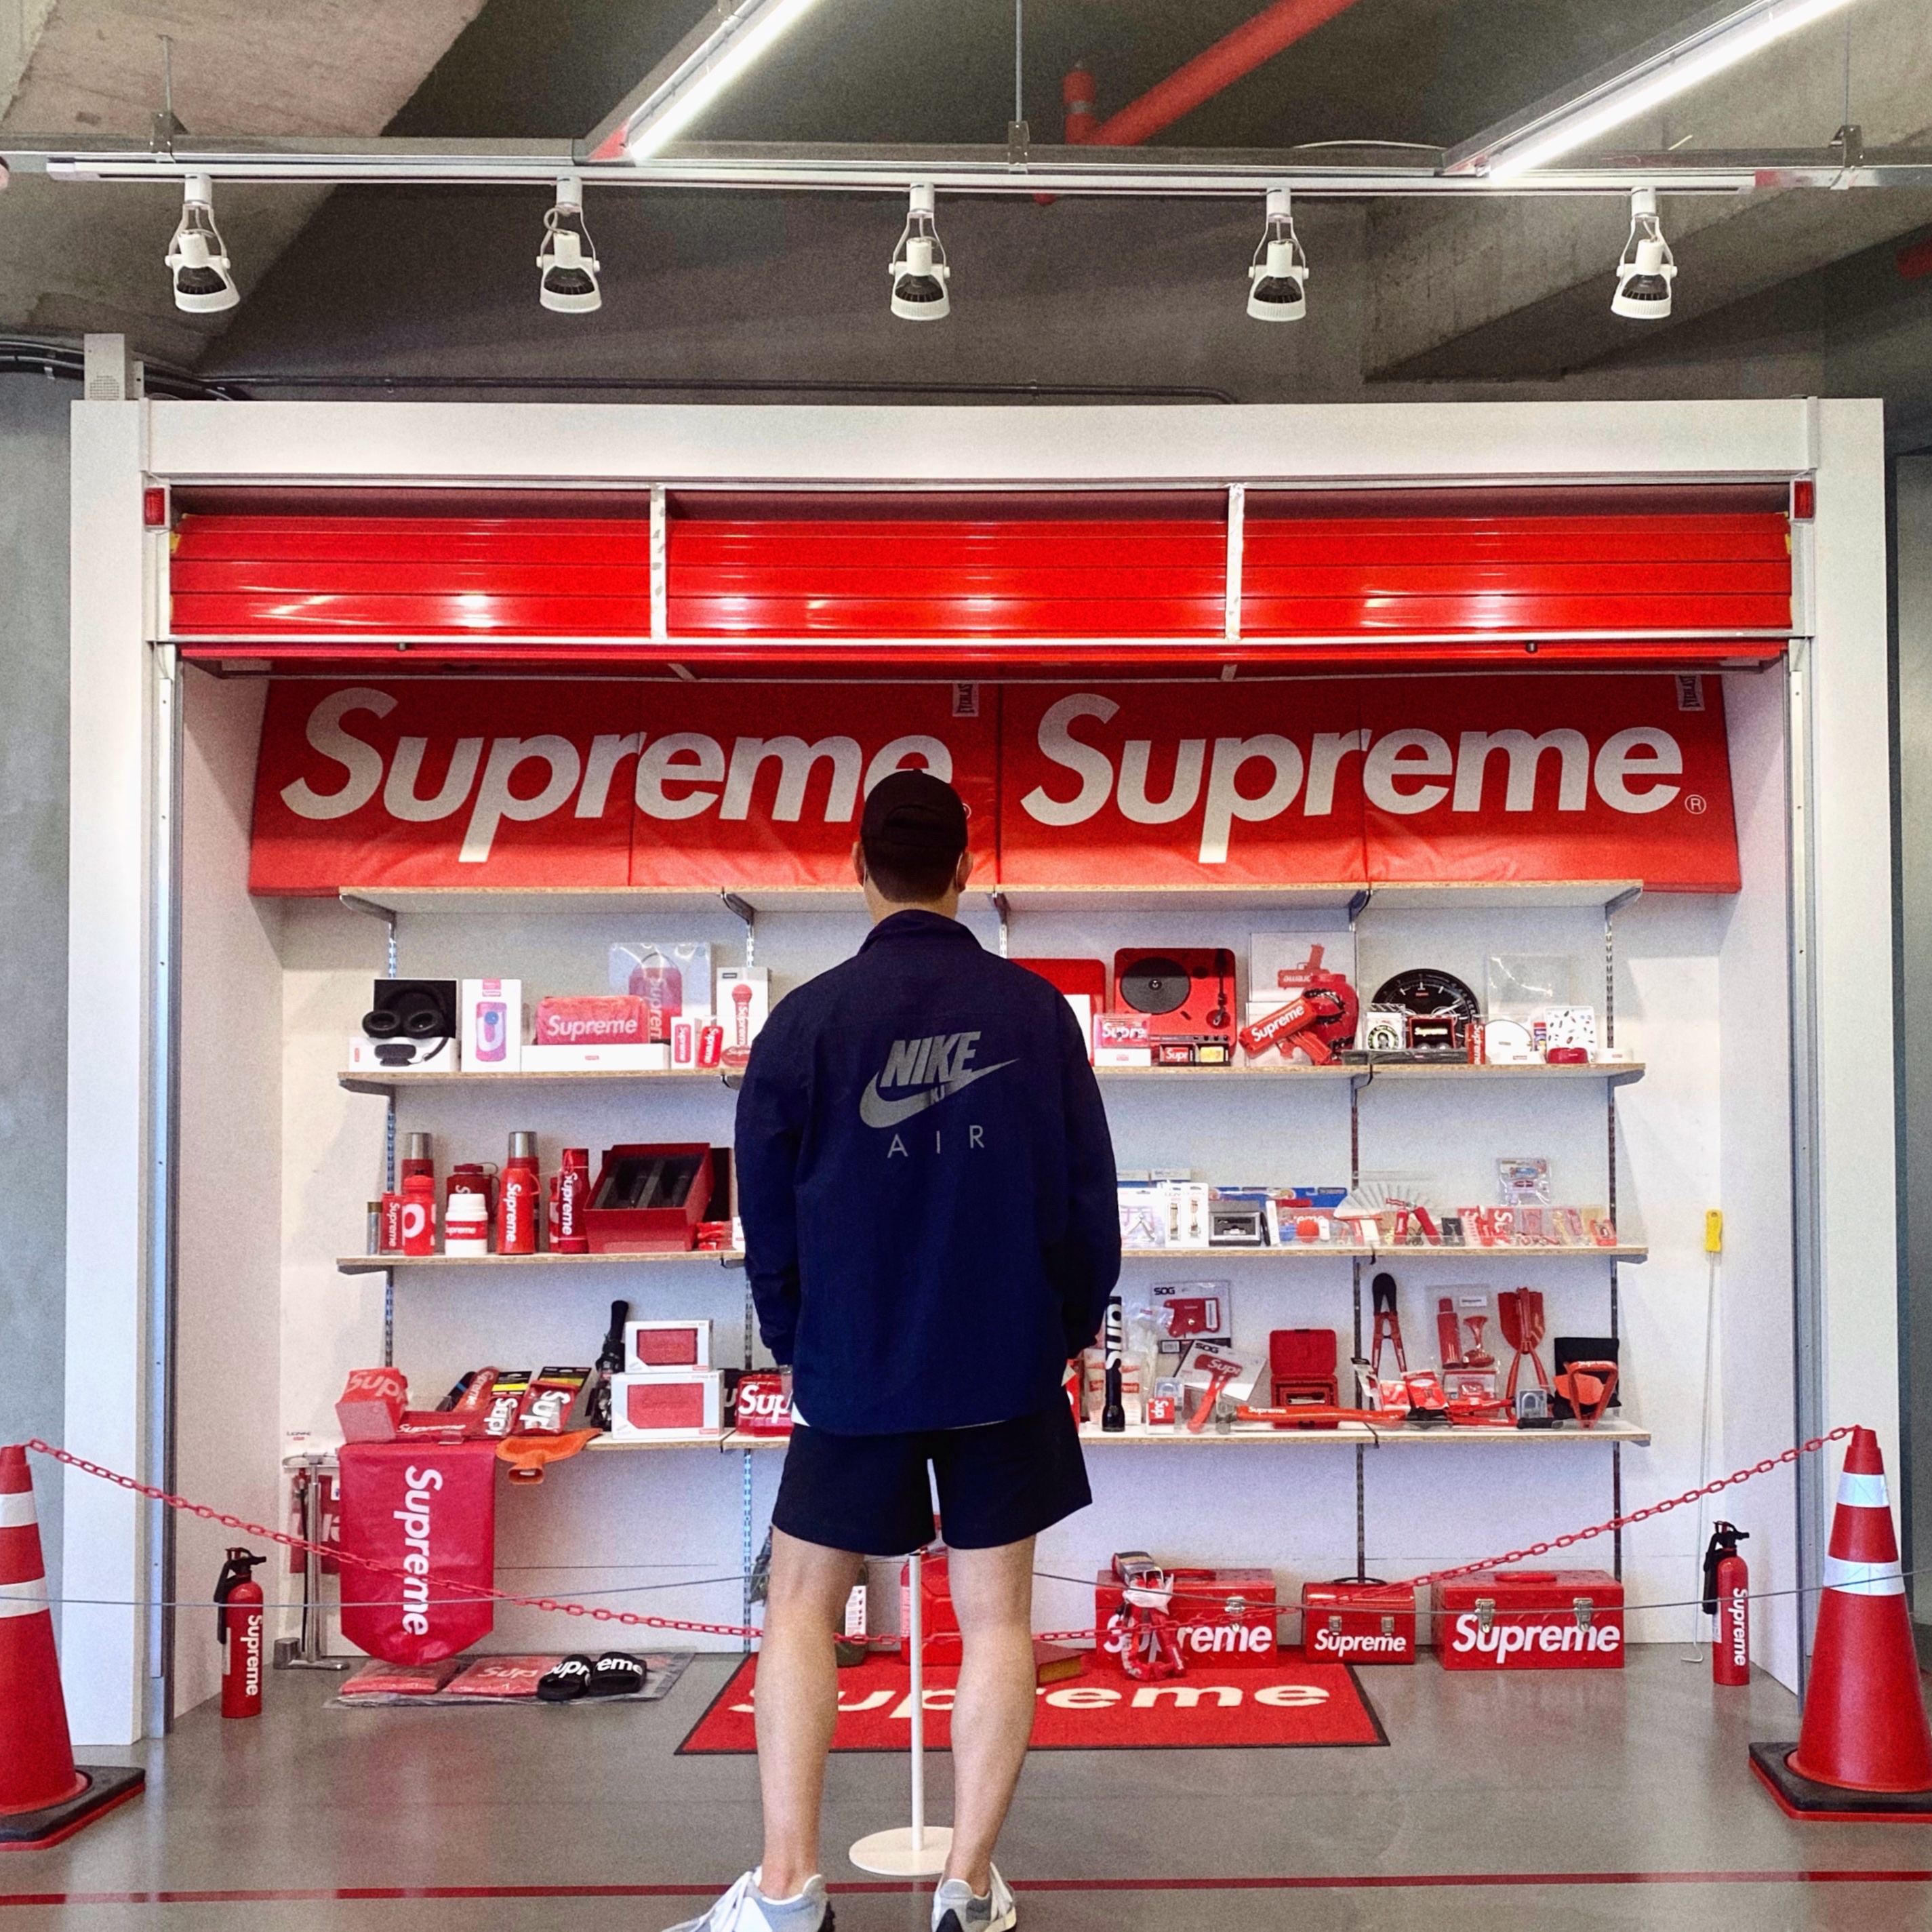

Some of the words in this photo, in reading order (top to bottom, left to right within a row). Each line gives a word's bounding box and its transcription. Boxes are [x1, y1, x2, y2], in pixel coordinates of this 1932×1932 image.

[1020, 693, 1683, 863] Supreme
[547, 1015, 638, 1041] Supreme
[678, 1026, 688, 1062] Supreme
[1251, 1005, 1304, 1042] Supreme
[704, 1028, 719, 1064] Supreme
[880, 1031, 981, 1087] NIKE
[1471, 1024, 1483, 1065] Supreme
[887, 1125, 984, 1158] AIR
[503, 1182, 522, 1242] Supreme
[561, 1171, 578, 1235] Supreme
[386, 1202, 400, 1247] Supreme
[1154, 1287, 1175, 1295] SOG
[1194, 1342, 1219, 1354] SOG
[393, 1466, 443, 1636] Supreme
[1314, 1629, 1406, 1657] Supreme
[1452, 1613, 1620, 1664] Supreme
[1733, 1587, 1748, 1667] Supreme
[239, 1614, 263, 1697] Supreme
[727, 1685, 1329, 1718] upeme
